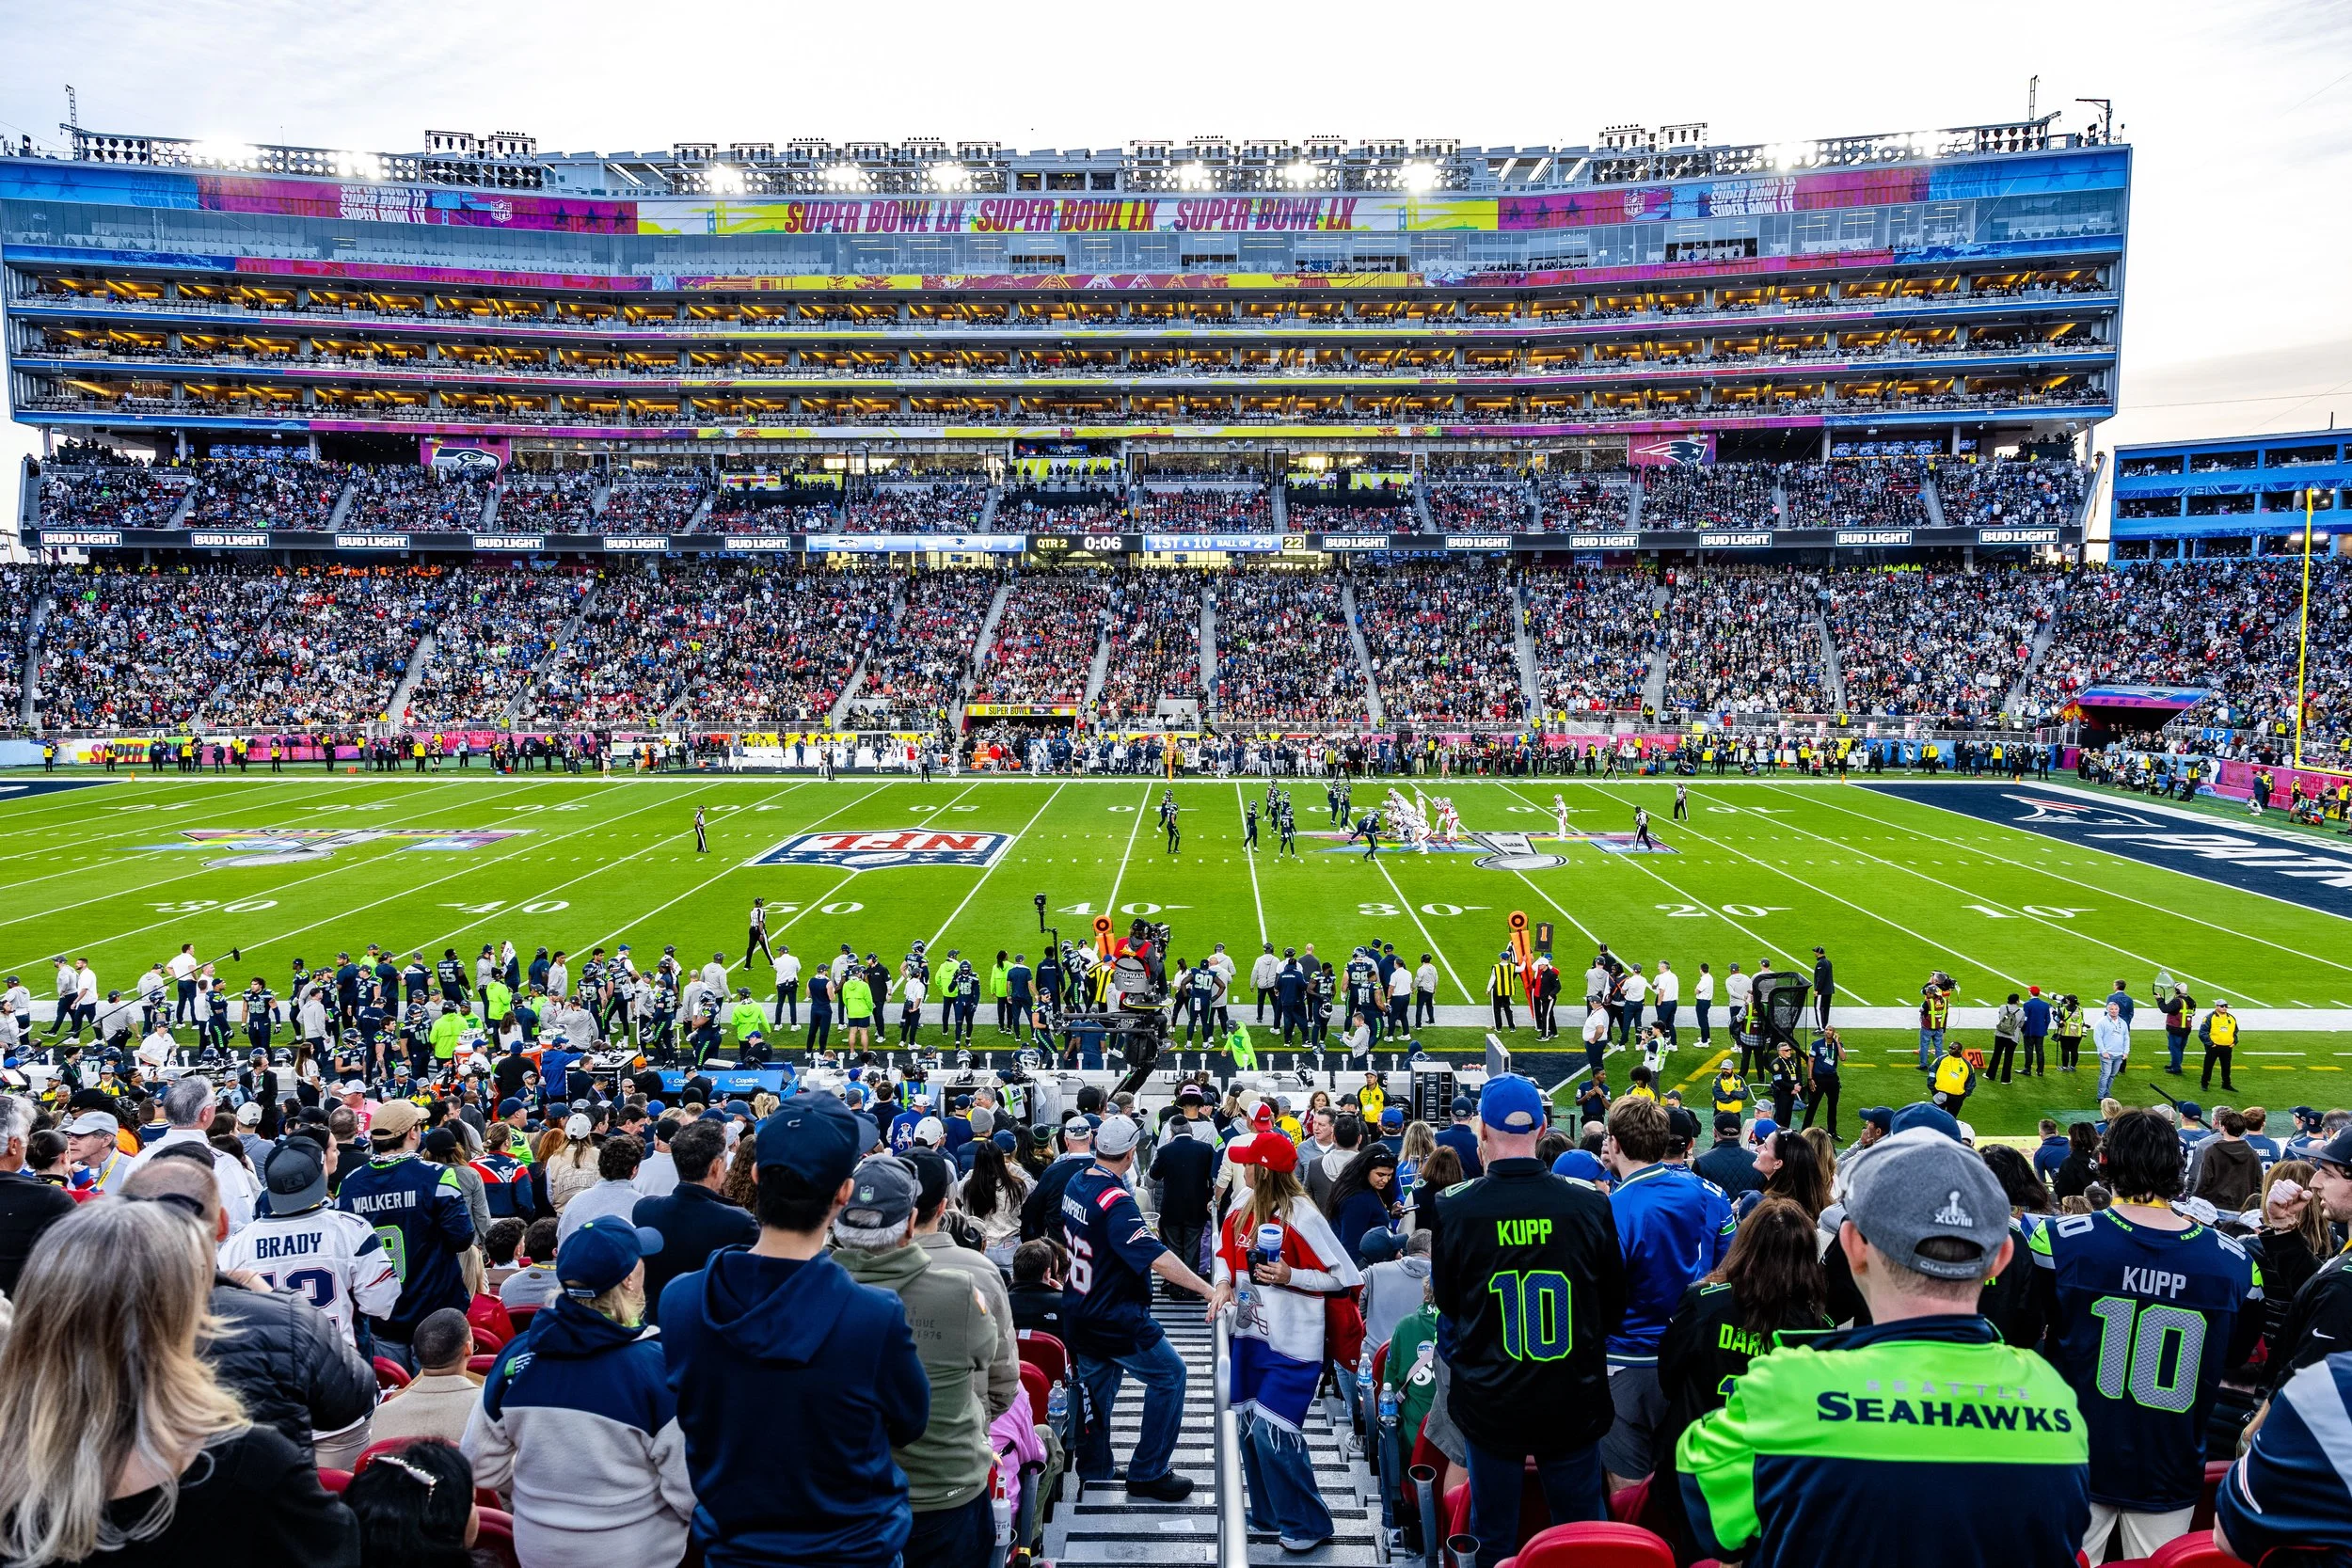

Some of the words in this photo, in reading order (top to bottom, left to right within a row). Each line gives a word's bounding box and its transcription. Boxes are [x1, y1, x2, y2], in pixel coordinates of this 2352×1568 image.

[785, 201, 855, 233] SUPER
[864, 201, 929, 232] BOWL
[934, 201, 963, 232] LX
[977, 200, 1055, 232] SUPER
[1058, 199, 1123, 231] BOWL
[1126, 199, 1157, 231] LX
[1174, 198, 1252, 231] SUPER
[1256, 198, 1320, 231] BOWL
[1325, 198, 1359, 230] LX
[43, 533, 74, 545] BUD
[75, 533, 119, 545] LIGHT
[195, 535, 225, 546] BUD
[226, 535, 265, 546] LIGHT
[338, 536, 368, 547] BUD
[368, 536, 406, 547] LIGHT
[1153, 536, 1179, 548] 1ST
[1193, 536, 1211, 548] 10
[1254, 537, 1272, 548] 29
[1285, 537, 1302, 548] 22
[1448, 538, 1473, 547] BUD
[1474, 538, 1509, 547] LIGHT
[1572, 536, 1599, 547] BUD
[1600, 536, 1635, 547] LIGHT
[1702, 534, 1730, 546] BUD
[1731, 534, 1770, 546] LIGHT
[1838, 531, 1870, 544] BUD
[1871, 531, 1908, 544] LIGHT
[1981, 530, 2011, 542] BUD
[2012, 530, 2055, 542] LIGHT
[475, 538, 506, 548] BUD
[507, 538, 541, 548] LIGHT
[606, 538, 630, 549] BUD
[630, 538, 666, 549] LIGHT
[727, 539, 754, 549] BUD
[754, 539, 787, 549] LIGHT
[873, 537, 884, 549] 9
[1038, 539, 1059, 548] QTR
[1061, 539, 1067, 547] 2
[1085, 536, 1121, 550] 0:06
[1325, 538, 1352, 548] BUD
[1352, 538, 1386, 548] LIGHT
[989, 706, 1009, 715] SUPER
[1010, 706, 1027, 715] BOWL
[2209, 731, 2226, 742] 12
[2300, 775, 2324, 789] SUPER
[1056, 902, 1161, 915] 40
[1358, 903, 1464, 916] 30
[1655, 904, 1769, 917] 20
[1963, 905, 2075, 918] 10
[1540, 926, 1549, 942] 1
[1194, 973, 1212, 990] 90
[358, 985, 368, 999] 2
[1966, 1053, 1984, 1068] 20
[674, 1077, 691, 1087] Copi
[735, 1077, 758, 1087] Copilot
[353, 1192, 402, 1213] WALKER
[404, 1190, 416, 1208] III
[1062, 1194, 1089, 1226] CAMPBELL
[1934, 1213, 1973, 1227] XLVIII
[1497, 1219, 1552, 1246] KUPP
[256, 1232, 323, 1259] BRADY
[2122, 1265, 2187, 1299] KUPP
[1488, 1270, 1572, 1362] 10
[2090, 1295, 2208, 1413] 10
[1866, 1380, 2030, 1400] SEATTLE
[1817, 1390, 2073, 1433] SEAHAWKS
